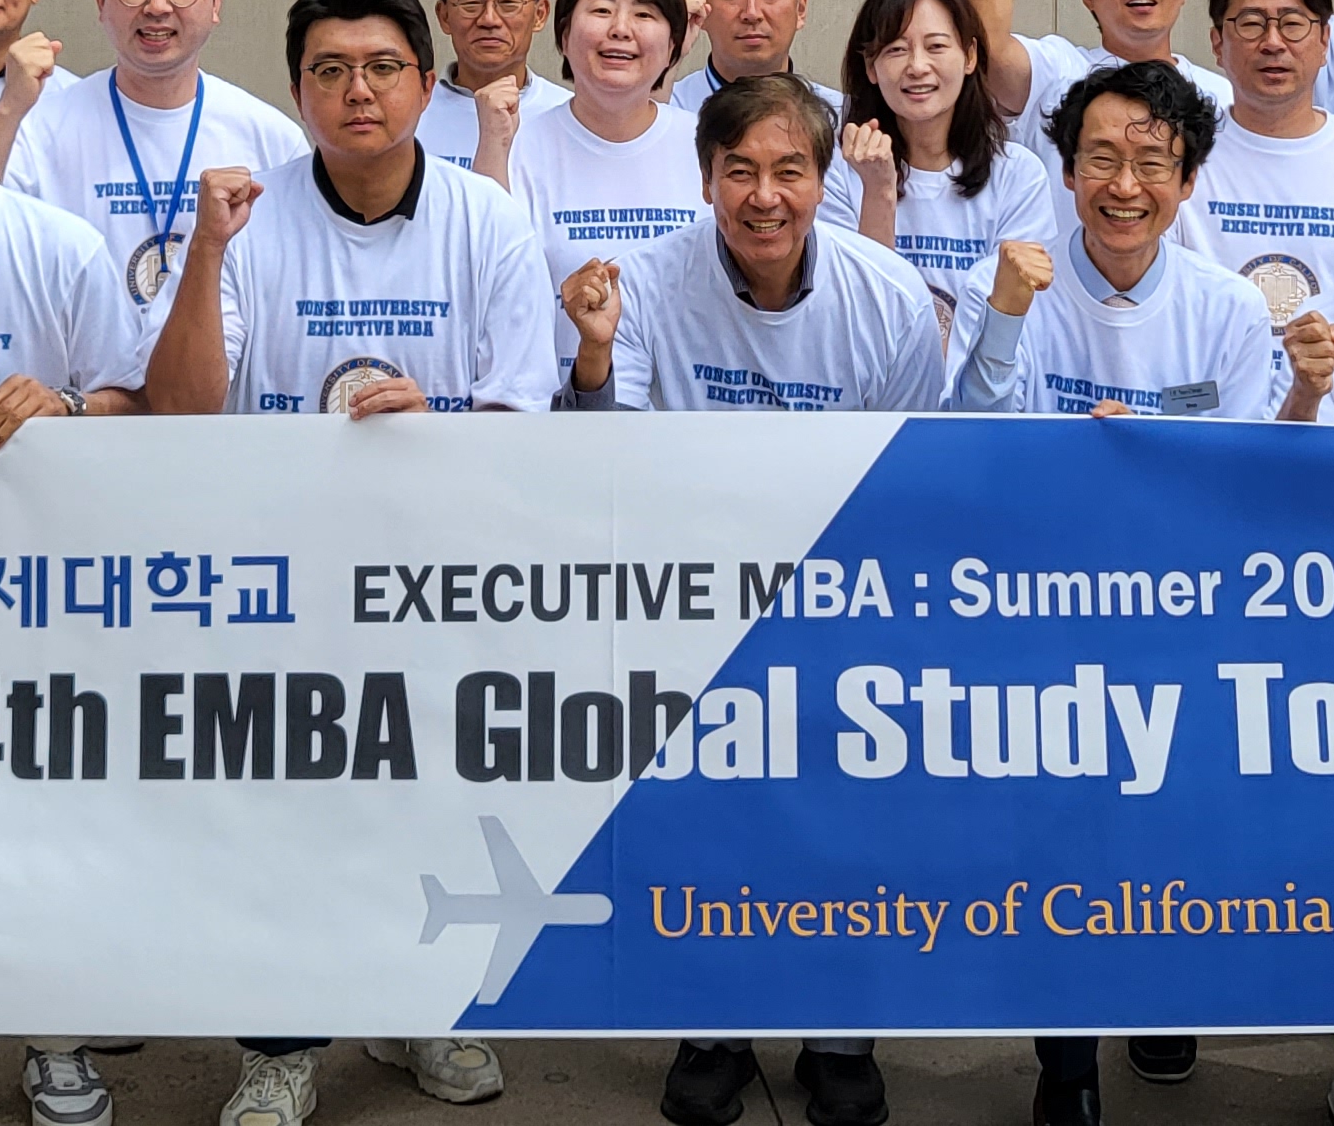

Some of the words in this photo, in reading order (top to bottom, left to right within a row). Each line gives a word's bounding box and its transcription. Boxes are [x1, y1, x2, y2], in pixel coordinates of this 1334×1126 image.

[553, 209, 605, 224] YONSEI
[608, 208, 696, 223] UNIVERSITY
[1208, 201, 1260, 218] YONSEI
[568, 225, 650, 240] EXECUTIVE
[1221, 219, 1305, 236] EXECUTIVE
[349, 299, 450, 317] UNIVERSITY
[398, 320, 434, 337] MBA
[693, 364, 748, 386] YONSEI
[751, 371, 843, 402] UNIVERSITY
[260, 394, 304, 412] GST
[353, 562, 716, 623] EXECUTIVE
[740, 559, 894, 620] MBA
[948, 558, 1221, 618] Summer
[139, 672, 418, 781] EMBA
[455, 666, 798, 782] Global
[836, 664, 1182, 796] Study
[649, 885, 951, 953] University
[965, 881, 1029, 936] of
